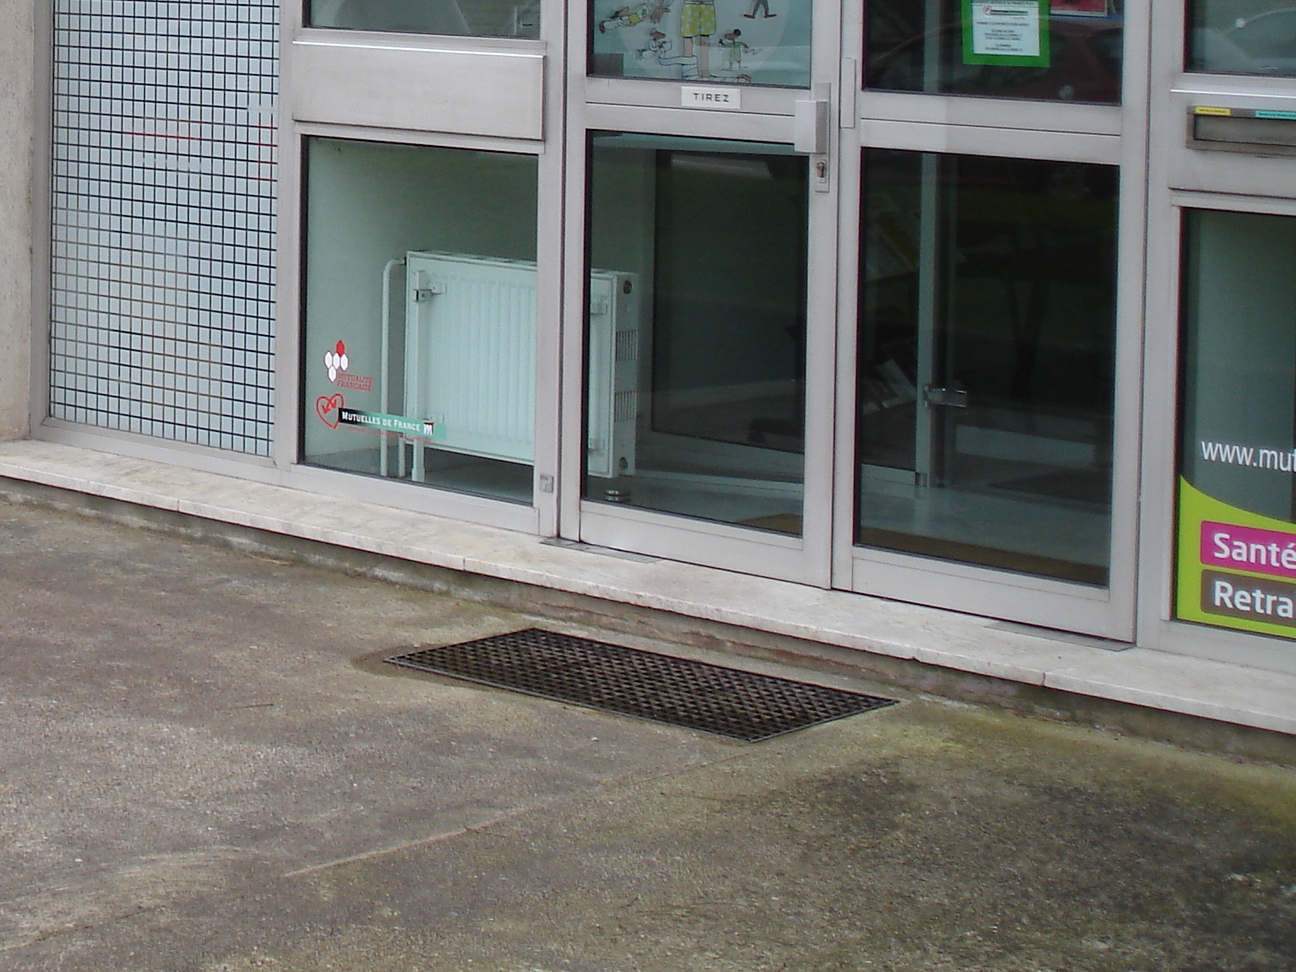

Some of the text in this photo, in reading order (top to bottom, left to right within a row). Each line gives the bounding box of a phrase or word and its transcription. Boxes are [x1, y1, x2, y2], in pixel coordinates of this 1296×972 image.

[693, 92, 729, 103] TIREZ
[1213, 532, 1296, 570] Santé
[1214, 580, 1294, 619] Retra
